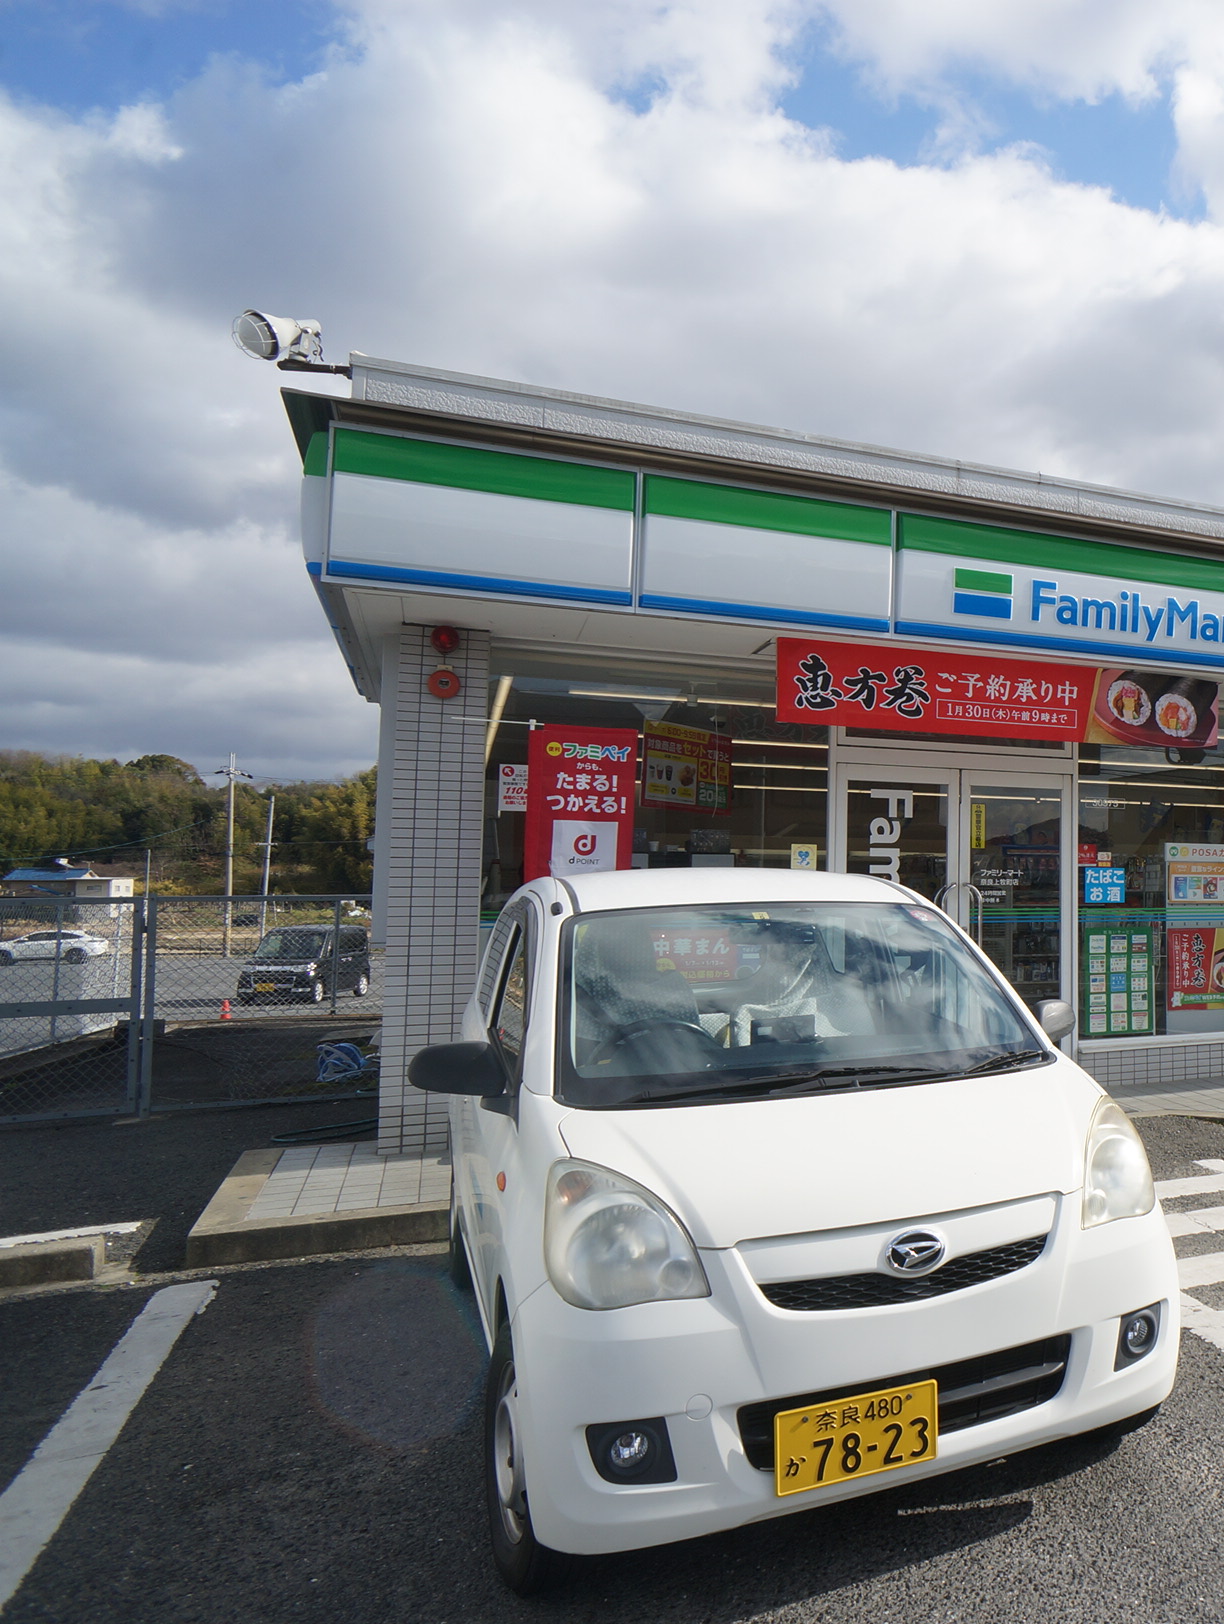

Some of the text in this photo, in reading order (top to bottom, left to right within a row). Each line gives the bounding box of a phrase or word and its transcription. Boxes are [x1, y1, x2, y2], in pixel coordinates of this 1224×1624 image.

[793, 652, 932, 719] 恵方巻
[935, 672, 1079, 706] ご予約承り中
[946, 703, 1068, 724] 1月30日(木)午前9時まで
[562, 742, 632, 762] ファミペイ
[556, 772, 618, 792] たまる!
[546, 794, 627, 814] つかえる!
[980, 869, 1024, 878] ファミリーマート
[1086, 869, 1125, 885] たばこ
[1089, 887, 1122, 902] お酒
[653, 938, 730, 957] 中華まん
[815, 1395, 903, 1432] 奈良 480
[786, 1416, 930, 1482] か 78-23
